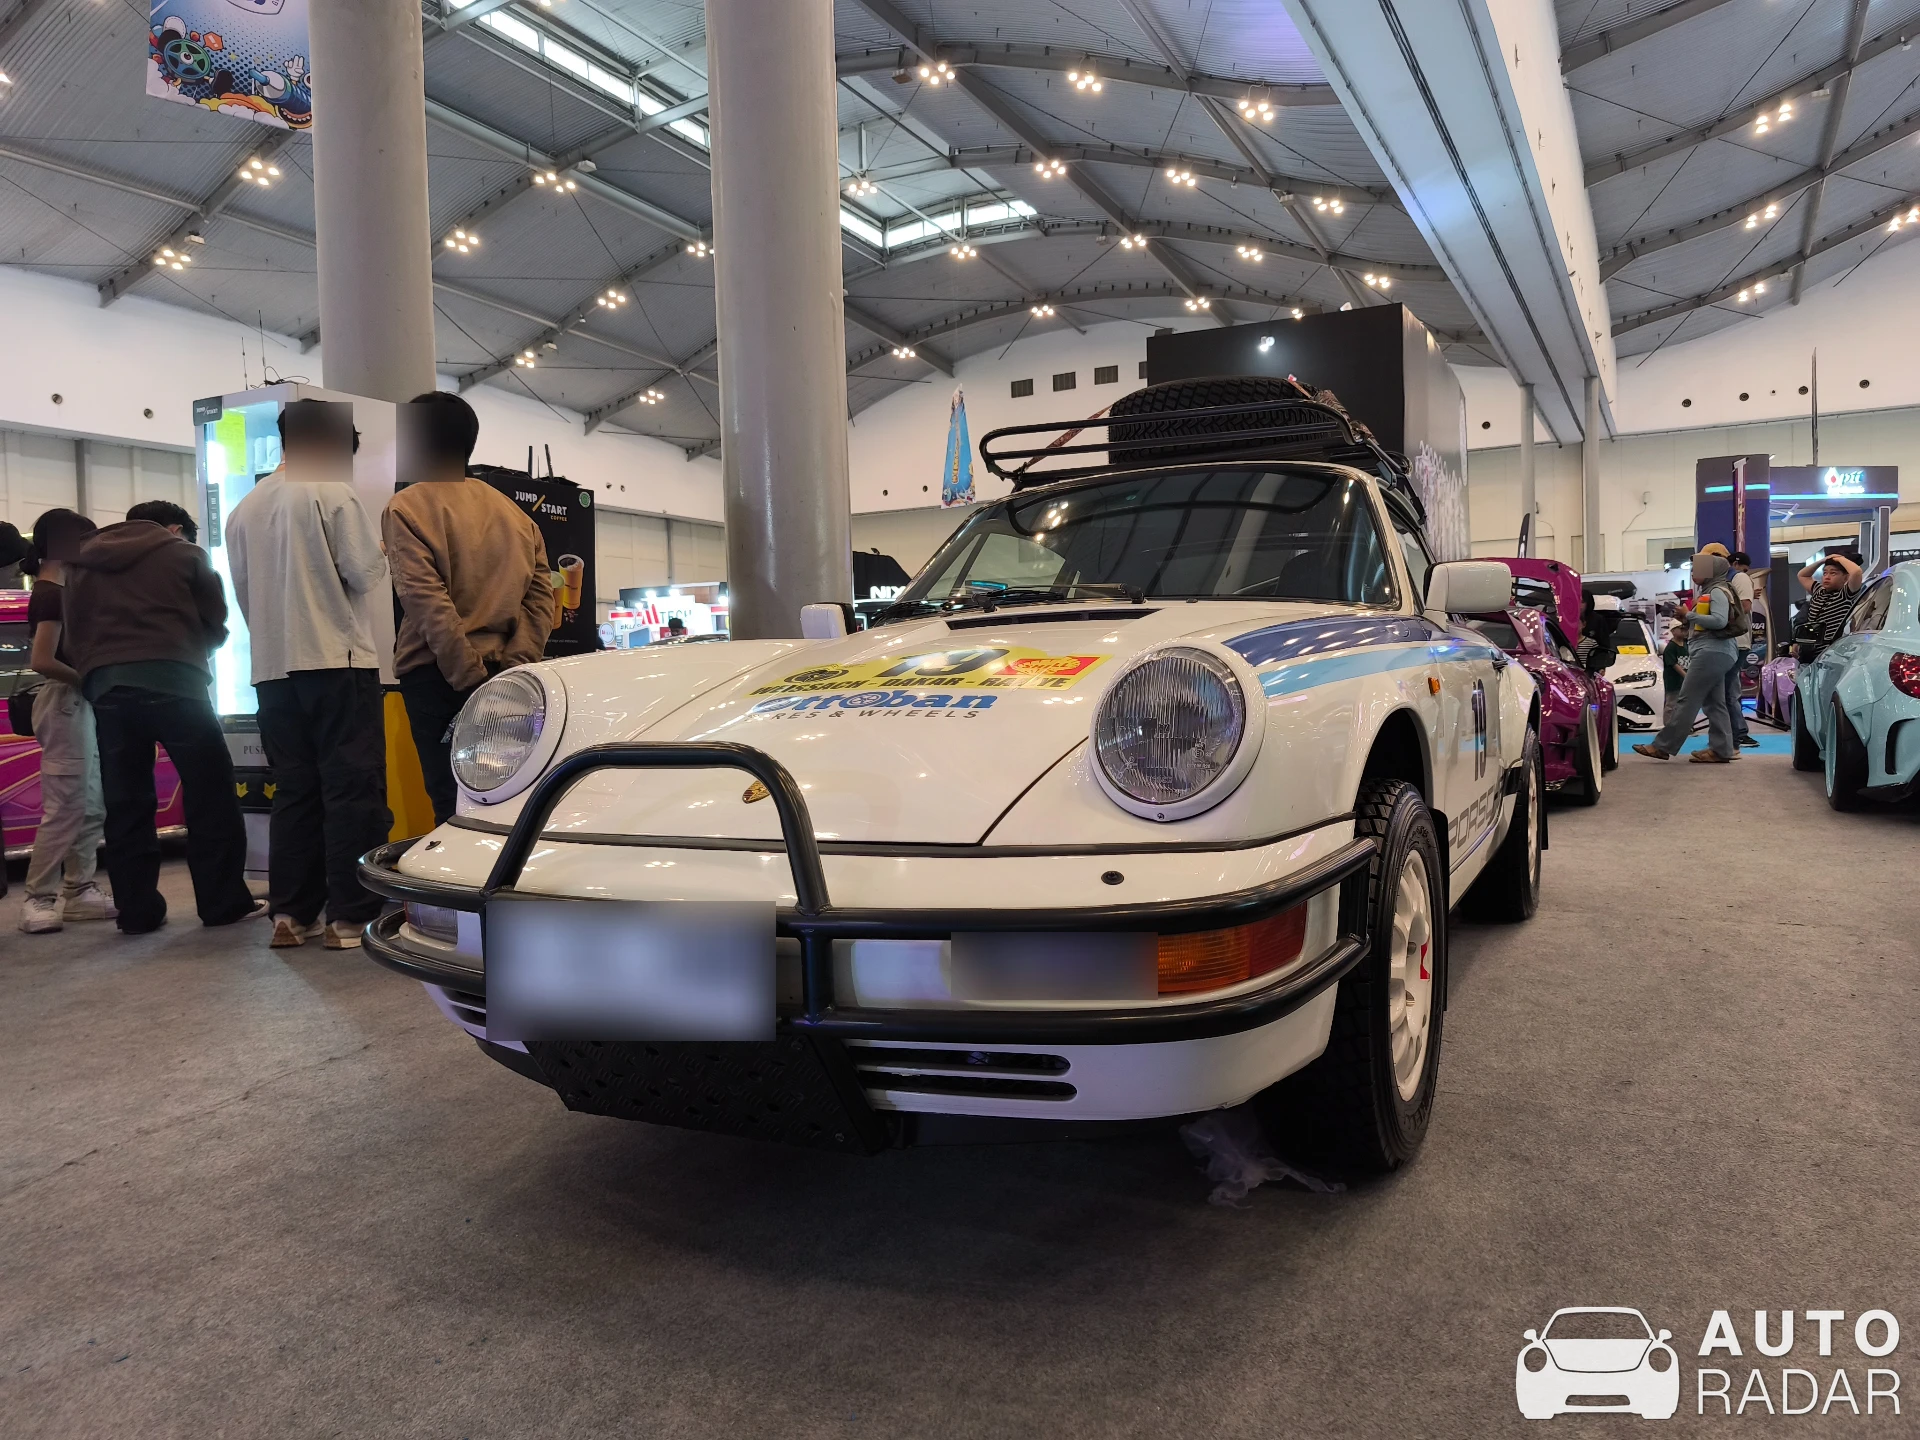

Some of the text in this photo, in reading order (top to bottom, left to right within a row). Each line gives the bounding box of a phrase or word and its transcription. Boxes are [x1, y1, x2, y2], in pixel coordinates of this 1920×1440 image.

[515, 491, 538, 503] JUMP
[541, 503, 567, 516] START
[873, 648, 1010, 677] 19
[749, 679, 870, 695] WEISSACH
[878, 677, 966, 687] DAKAR
[978, 677, 1071, 688] RALLYE
[752, 690, 998, 713] Ottoban
[828, 710, 845, 718] &
[858, 709, 979, 719] WHEELS
